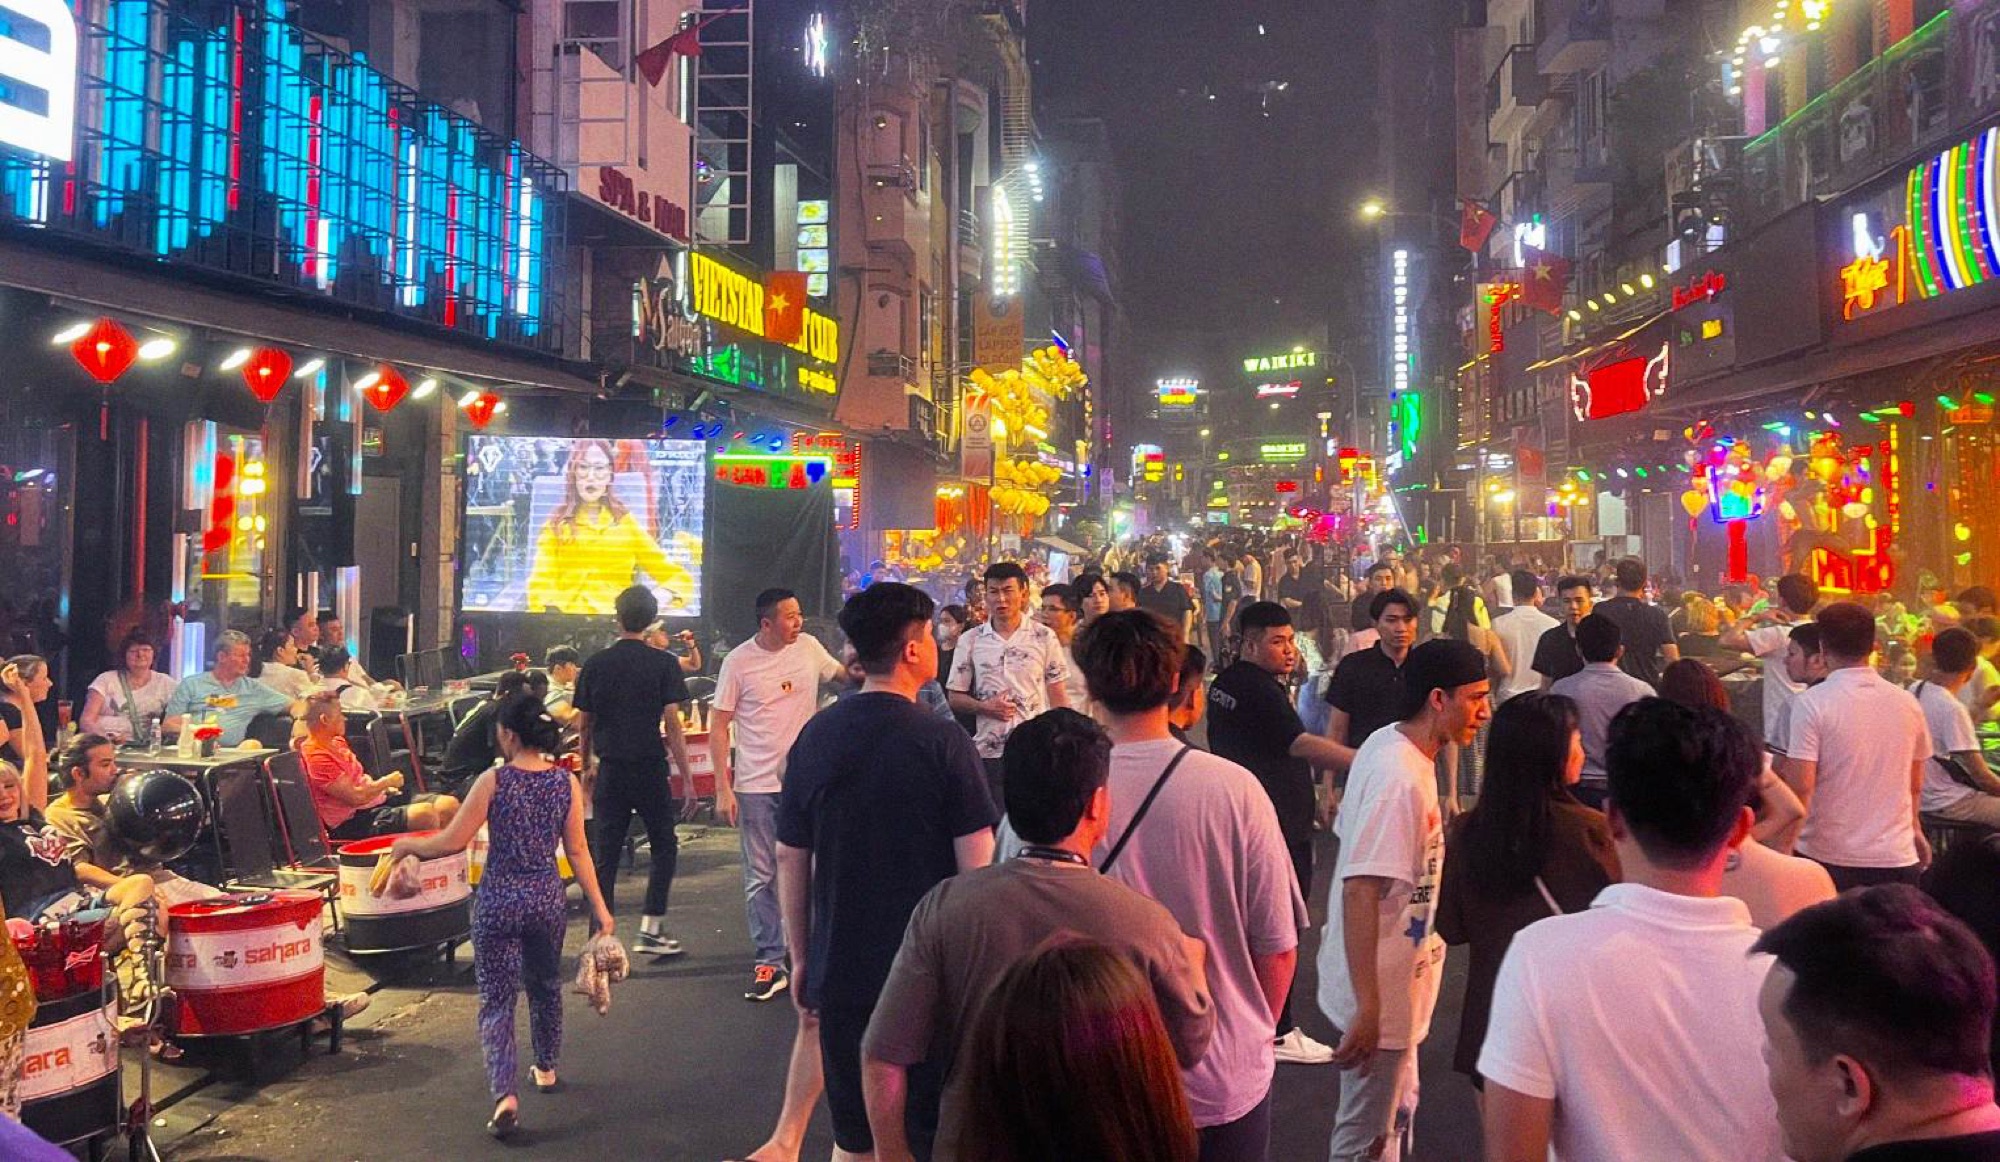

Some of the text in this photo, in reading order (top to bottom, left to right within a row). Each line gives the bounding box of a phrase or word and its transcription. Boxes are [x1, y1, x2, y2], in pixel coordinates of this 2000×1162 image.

[599, 166, 635, 215] SPA
[691, 251, 764, 336] VIETSTAR
[1243, 352, 1315, 372] WAIKIKI
[421, 875, 448, 889] ara
[171, 953, 197, 969] ara
[245, 938, 311, 964] sahara
[22, 1047, 70, 1080] ara
